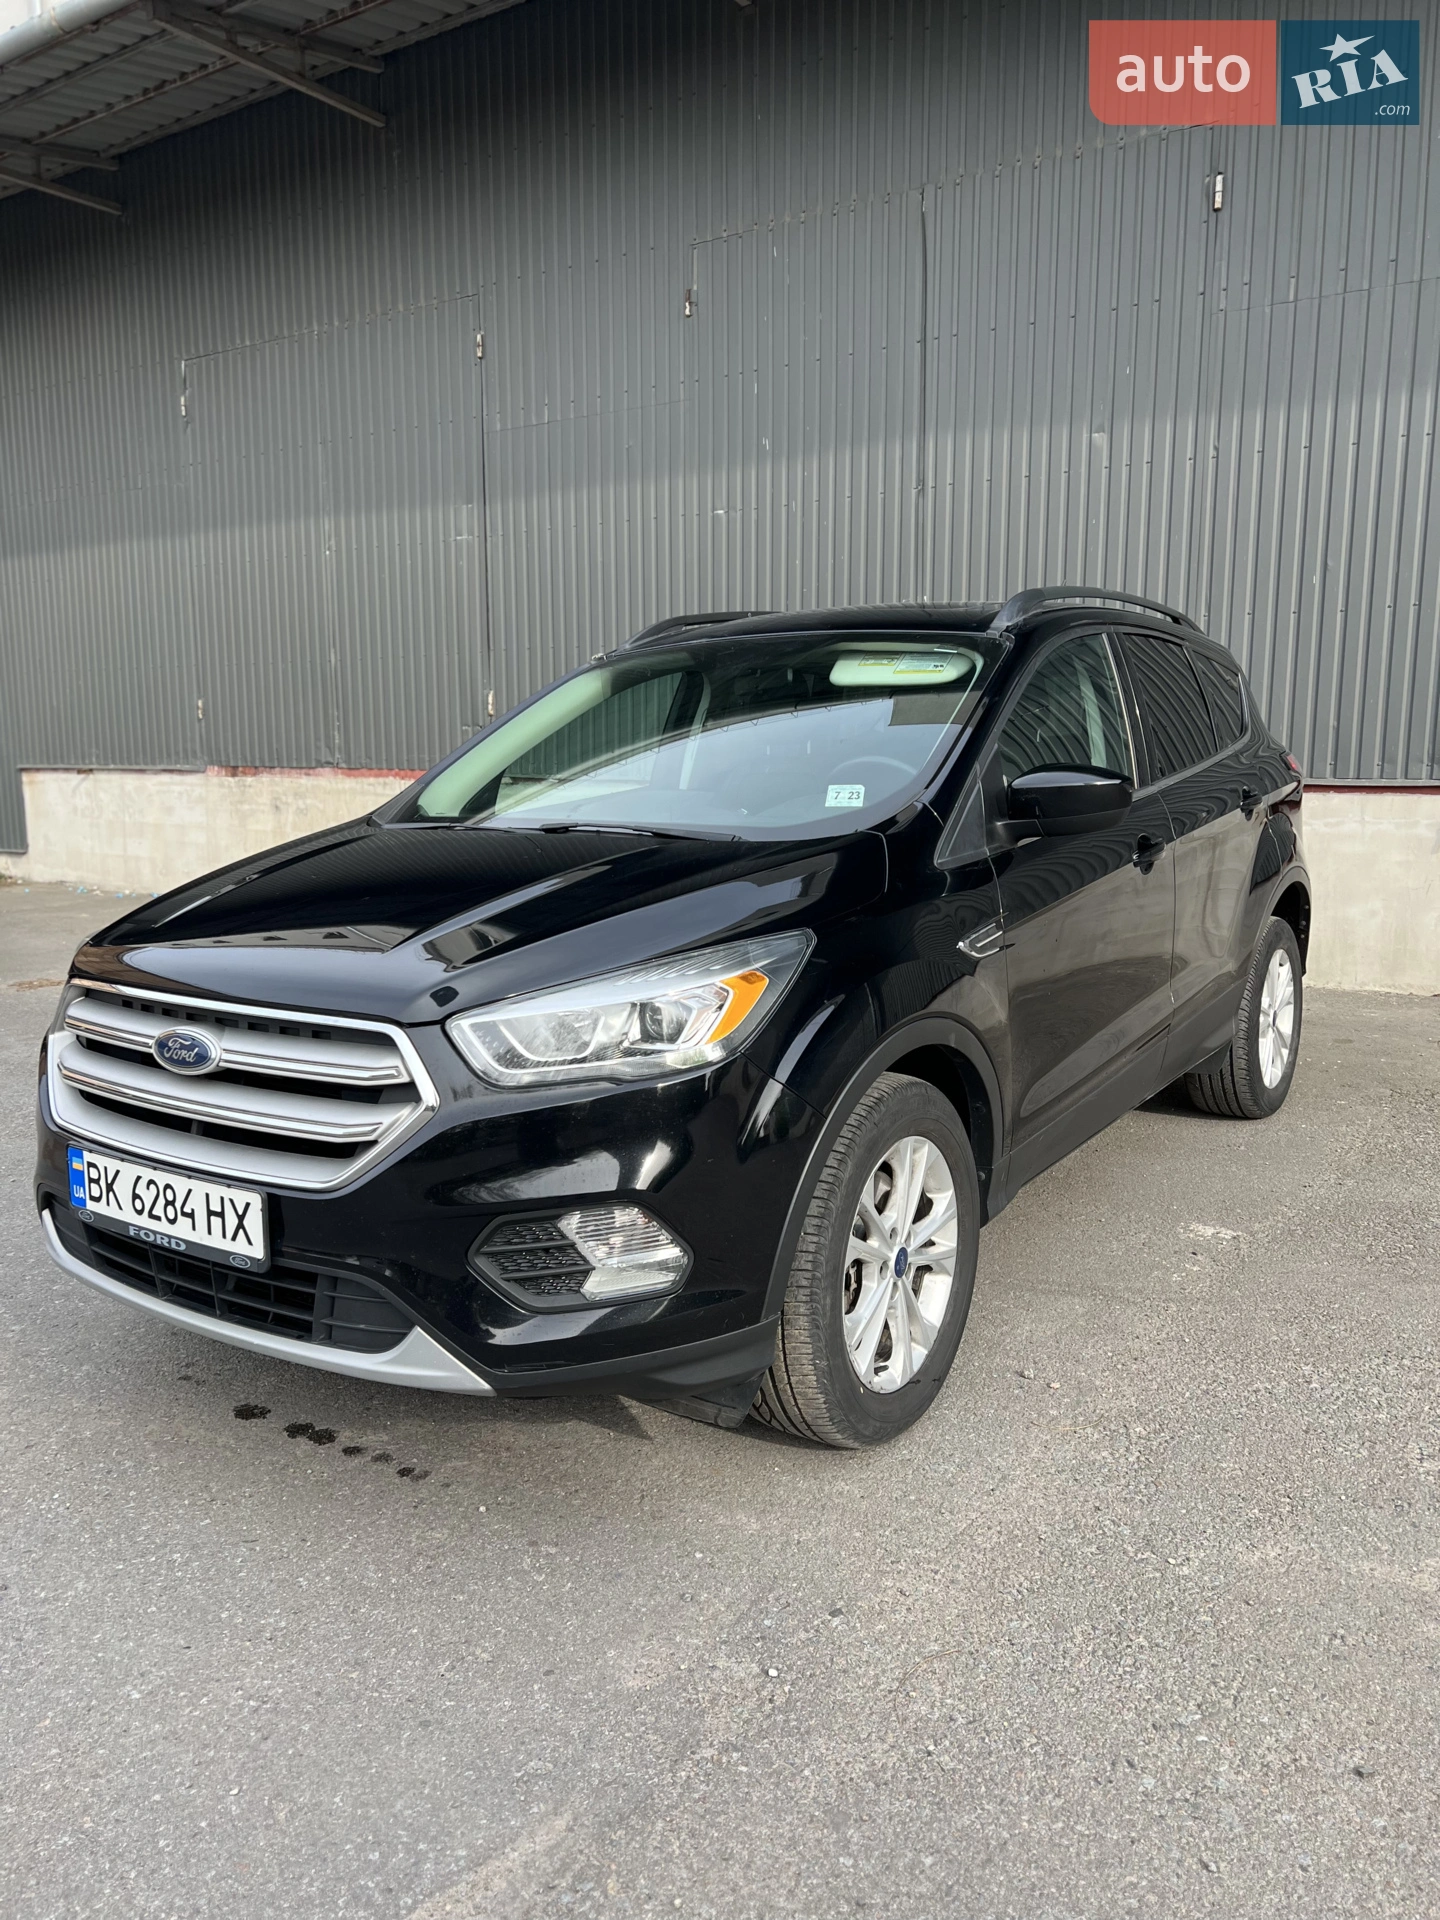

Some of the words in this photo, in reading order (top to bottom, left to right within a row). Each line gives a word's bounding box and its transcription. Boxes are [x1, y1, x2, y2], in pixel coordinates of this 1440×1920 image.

[834, 791, 841, 800] 7
[847, 791, 861, 800] 23
[163, 1037, 199, 1063] Ford
[73, 1184, 86, 1200] UA
[86, 1160, 123, 1211] BK
[131, 1175, 197, 1232] 6284
[205, 1192, 254, 1247] HX
[128, 1225, 187, 1251] FORD
